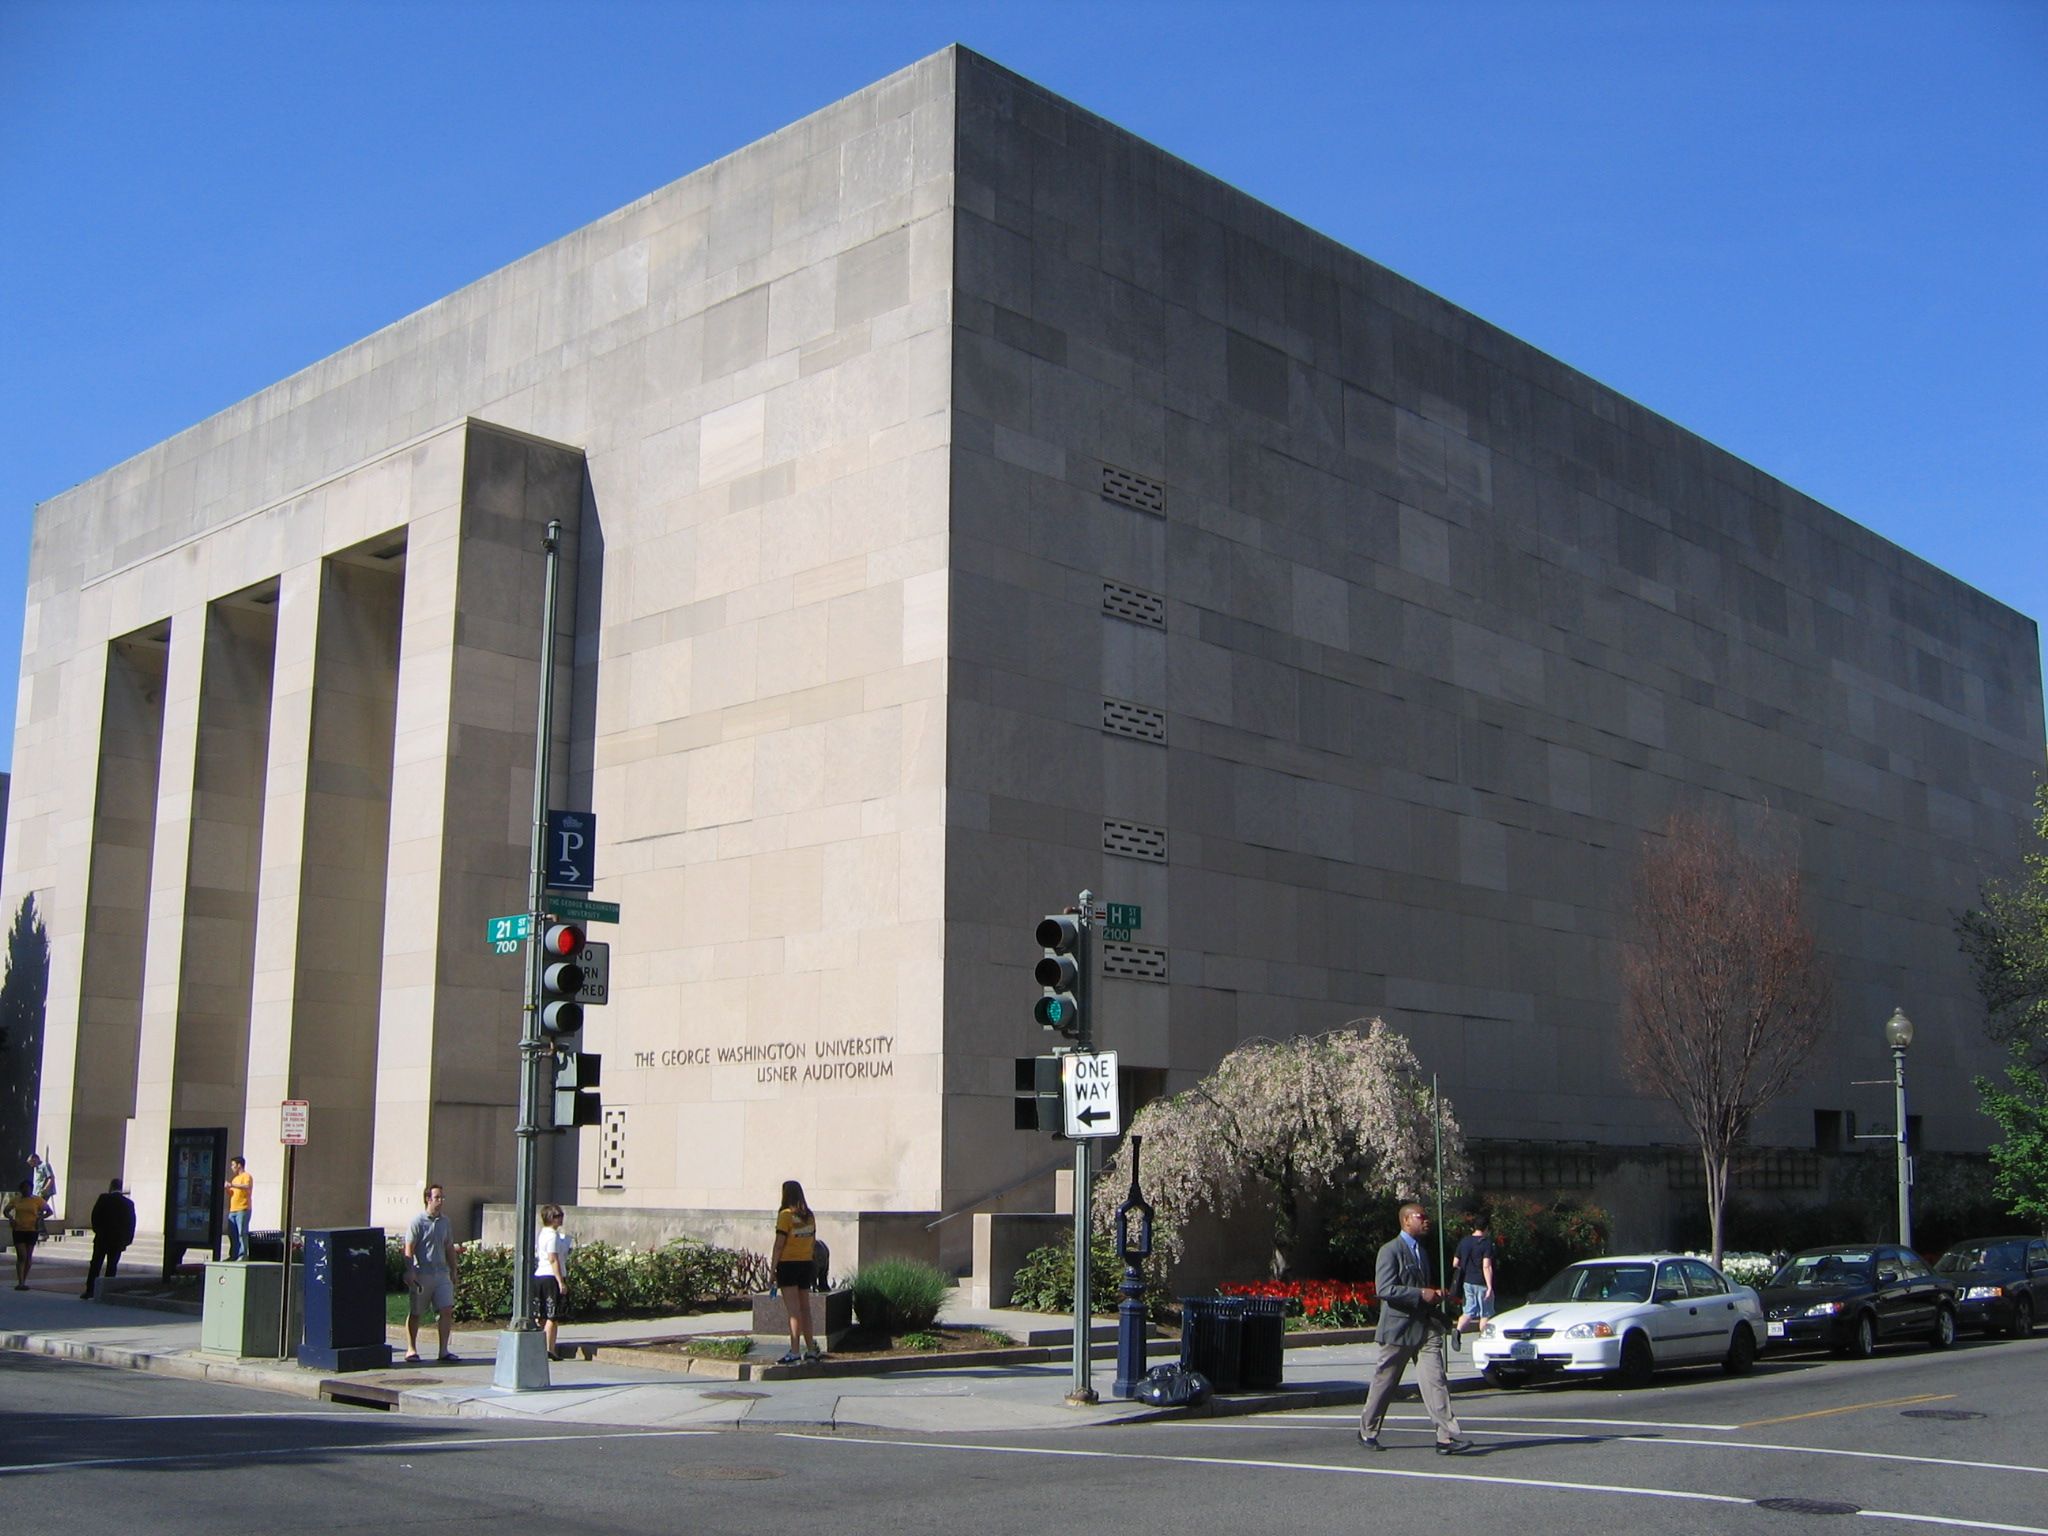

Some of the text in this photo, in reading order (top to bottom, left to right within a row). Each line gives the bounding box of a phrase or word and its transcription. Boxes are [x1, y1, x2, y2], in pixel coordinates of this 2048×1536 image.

[558, 831, 584, 863] P
[561, 899, 583, 909] GEORGE
[584, 902, 619, 913] WASHINGTON
[567, 909, 601, 919] UNIVERSITY
[1128, 907, 1137, 917] ST
[518, 917, 527, 927] ST
[1111, 905, 1122, 924] H
[496, 919, 511, 939] 21
[1103, 928, 1129, 942] 2100
[496, 940, 517, 954] 700
[582, 984, 605, 997] RED
[634, 1036, 894, 1068] THE GEORGE WASHINGTON UNIVERSITY
[803, 1060, 894, 1083] AUDITORIUM
[1075, 1060, 1109, 1079] ONE
[1075, 1081, 1111, 1101] WAY
